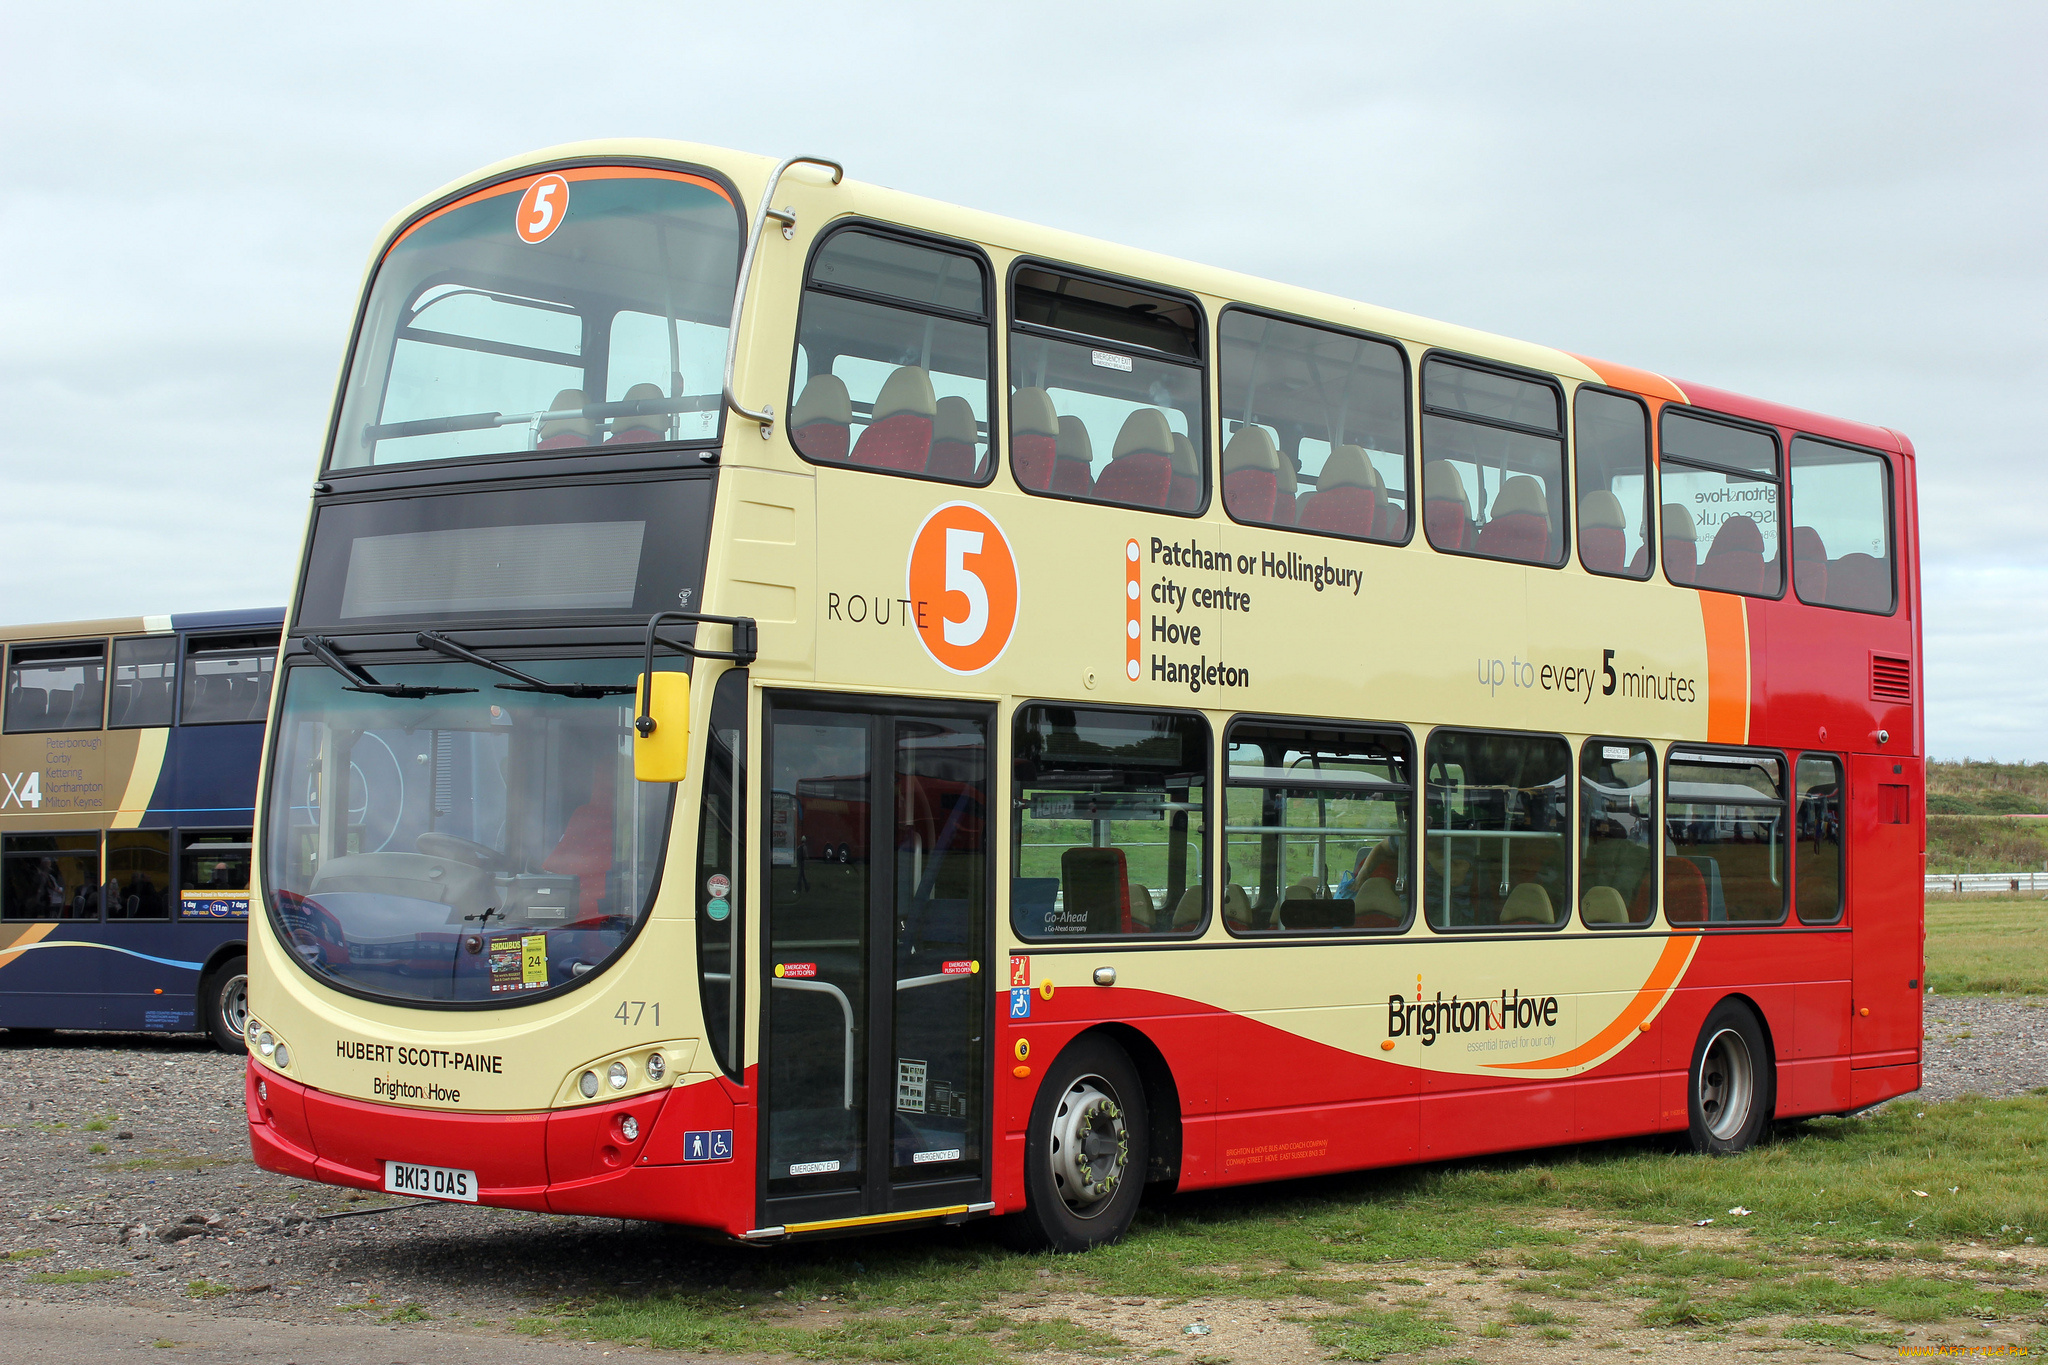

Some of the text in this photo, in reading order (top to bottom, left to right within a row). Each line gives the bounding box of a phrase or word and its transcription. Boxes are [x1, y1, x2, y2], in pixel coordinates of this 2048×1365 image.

[528, 183, 558, 234] 5
[1093, 351, 1131, 366] EMERGENCY EXIT
[1150, 536, 1364, 597] Patcham or Hollingbury
[943, 527, 989, 647] 5
[1151, 576, 1251, 614] city centre
[828, 592, 929, 629] ROUTE
[1151, 614, 1202, 646] Hove
[1151, 653, 1250, 693] Hangleton
[1477, 648, 1696, 705] up to every 5 minutes
[46, 736, 102, 751] Peterborough
[46, 752, 72, 766] Corby
[46, 766, 83, 781] Kettering
[1, 771, 43, 809] X4
[46, 782, 103, 795] Northampton
[46, 795, 103, 809] Milton Keynes
[188, 901, 197, 909] day
[236, 901, 248, 909] days
[1044, 911, 1089, 923] Go-Ahead
[491, 940, 522, 951] SHOWBUS
[528, 956, 541, 968] 24
[613, 1000, 661, 1027] 471
[1387, 984, 1559, 1047] Brighton&Hove
[1466, 1034, 1556, 1052] essential travel for our city
[336, 1040, 503, 1074] HUBERT SCOTT-PAINE
[373, 1074, 461, 1103] Brighton&Hove
[914, 1150, 959, 1162] EMERGENCY EXIT
[1226, 1148, 1250, 1156] BRIGHTON
[1290, 1141, 1306, 1150] COACH
[1306, 1139, 1328, 1148] COMPANY
[1280, 1152, 1291, 1160] EAST
[1291, 1150, 1308, 1159] SUSSEX
[791, 1162, 839, 1173] EMERGENCY EXIT
[394, 1165, 467, 1196] BK13 OAS
